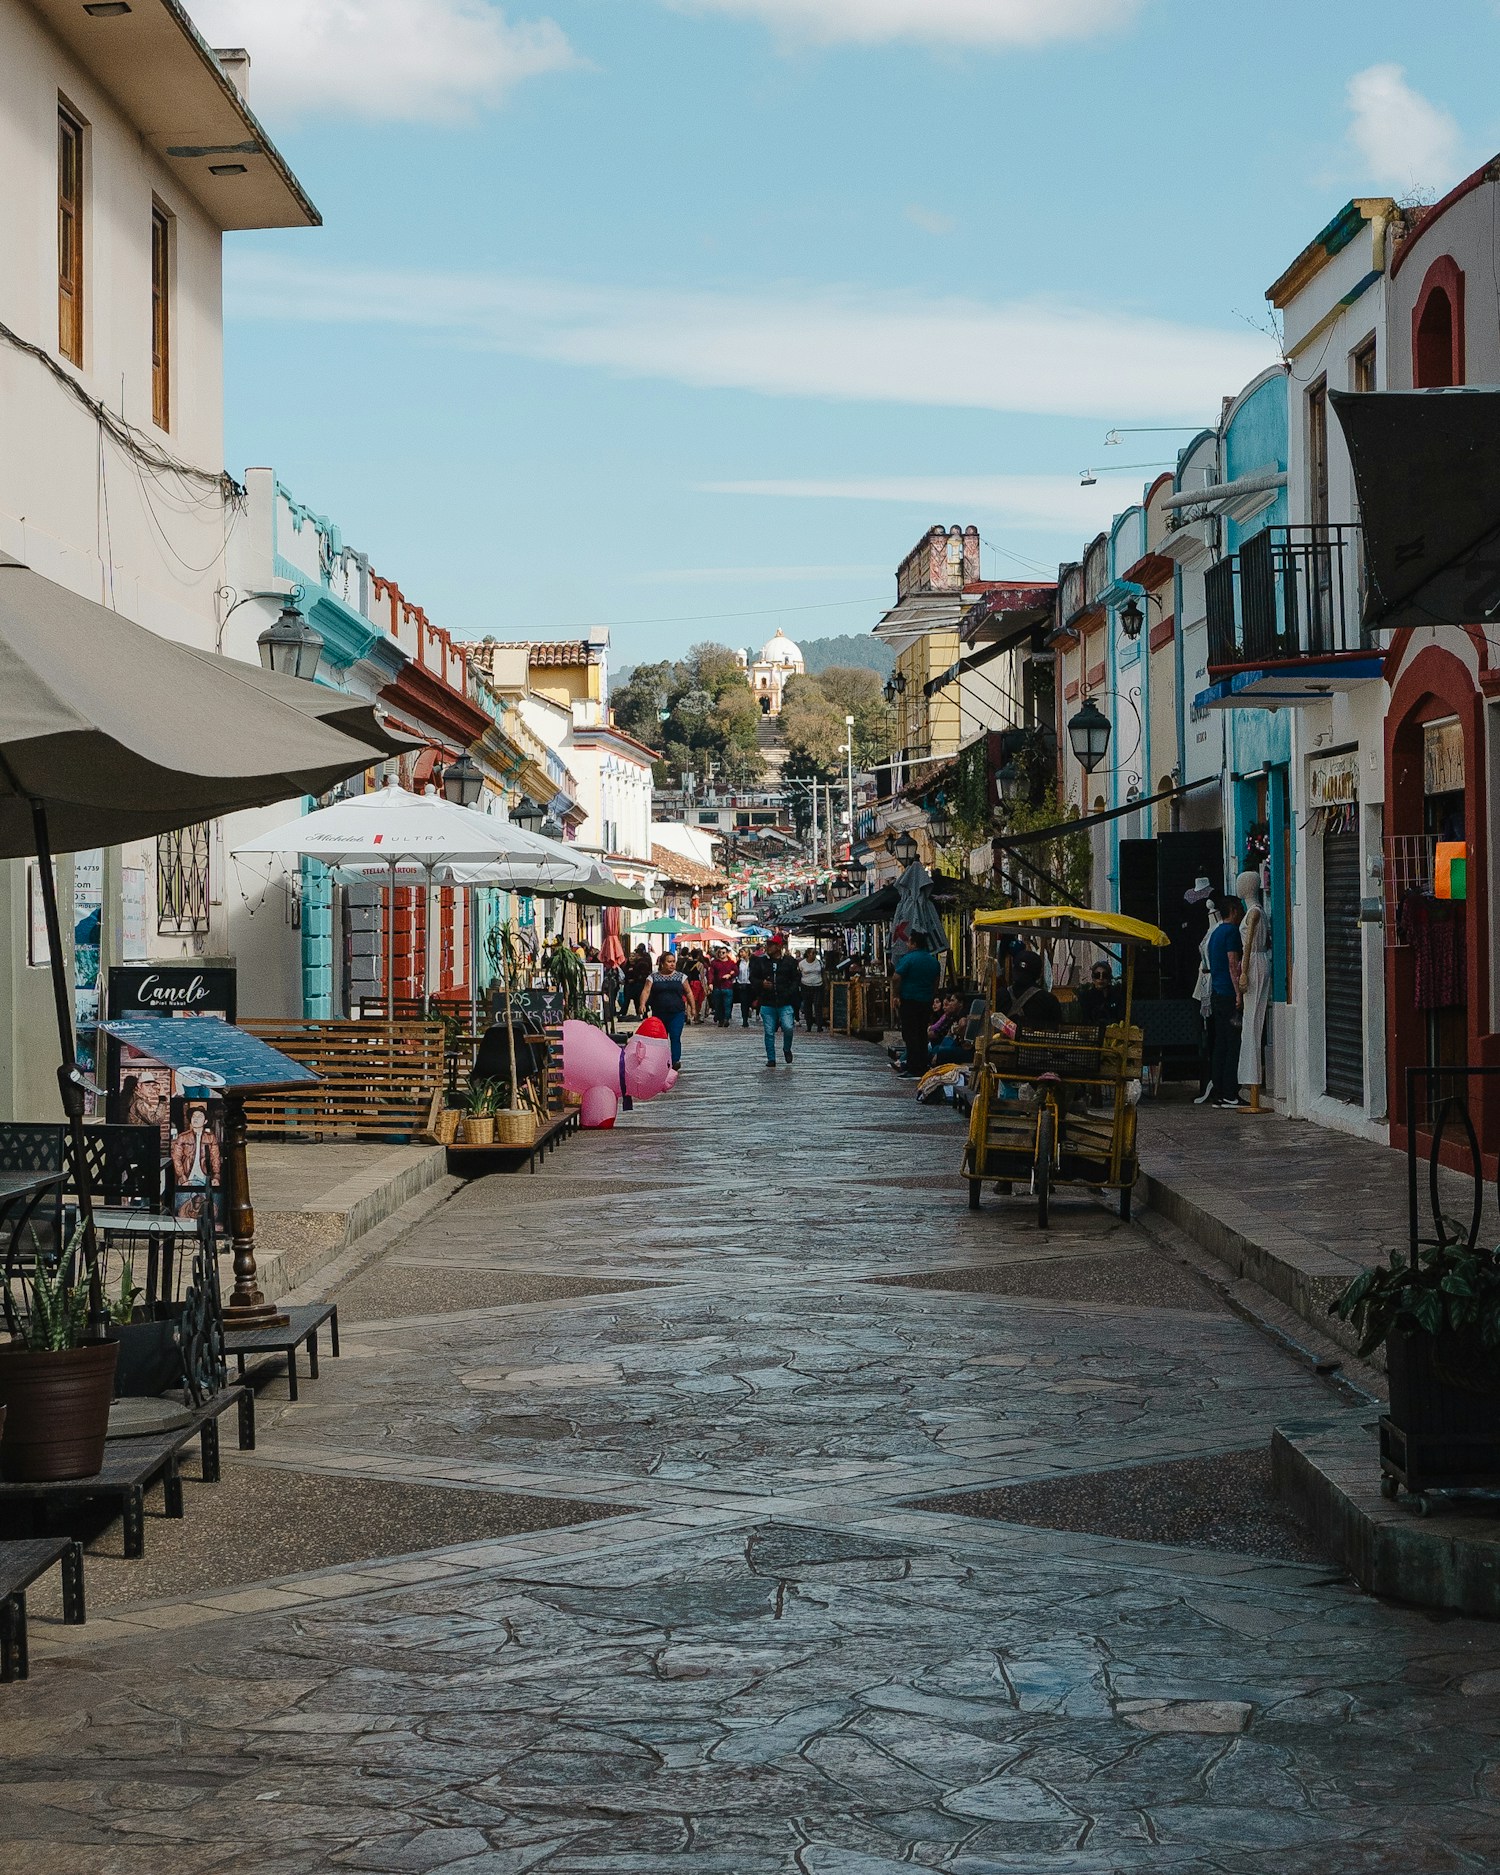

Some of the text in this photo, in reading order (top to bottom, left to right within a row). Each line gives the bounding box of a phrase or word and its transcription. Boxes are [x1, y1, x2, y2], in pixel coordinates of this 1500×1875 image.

[305, 832, 364, 843] Michelob
[362, 867, 385, 875] STELLA
[138, 974, 210, 1003] Canelo
